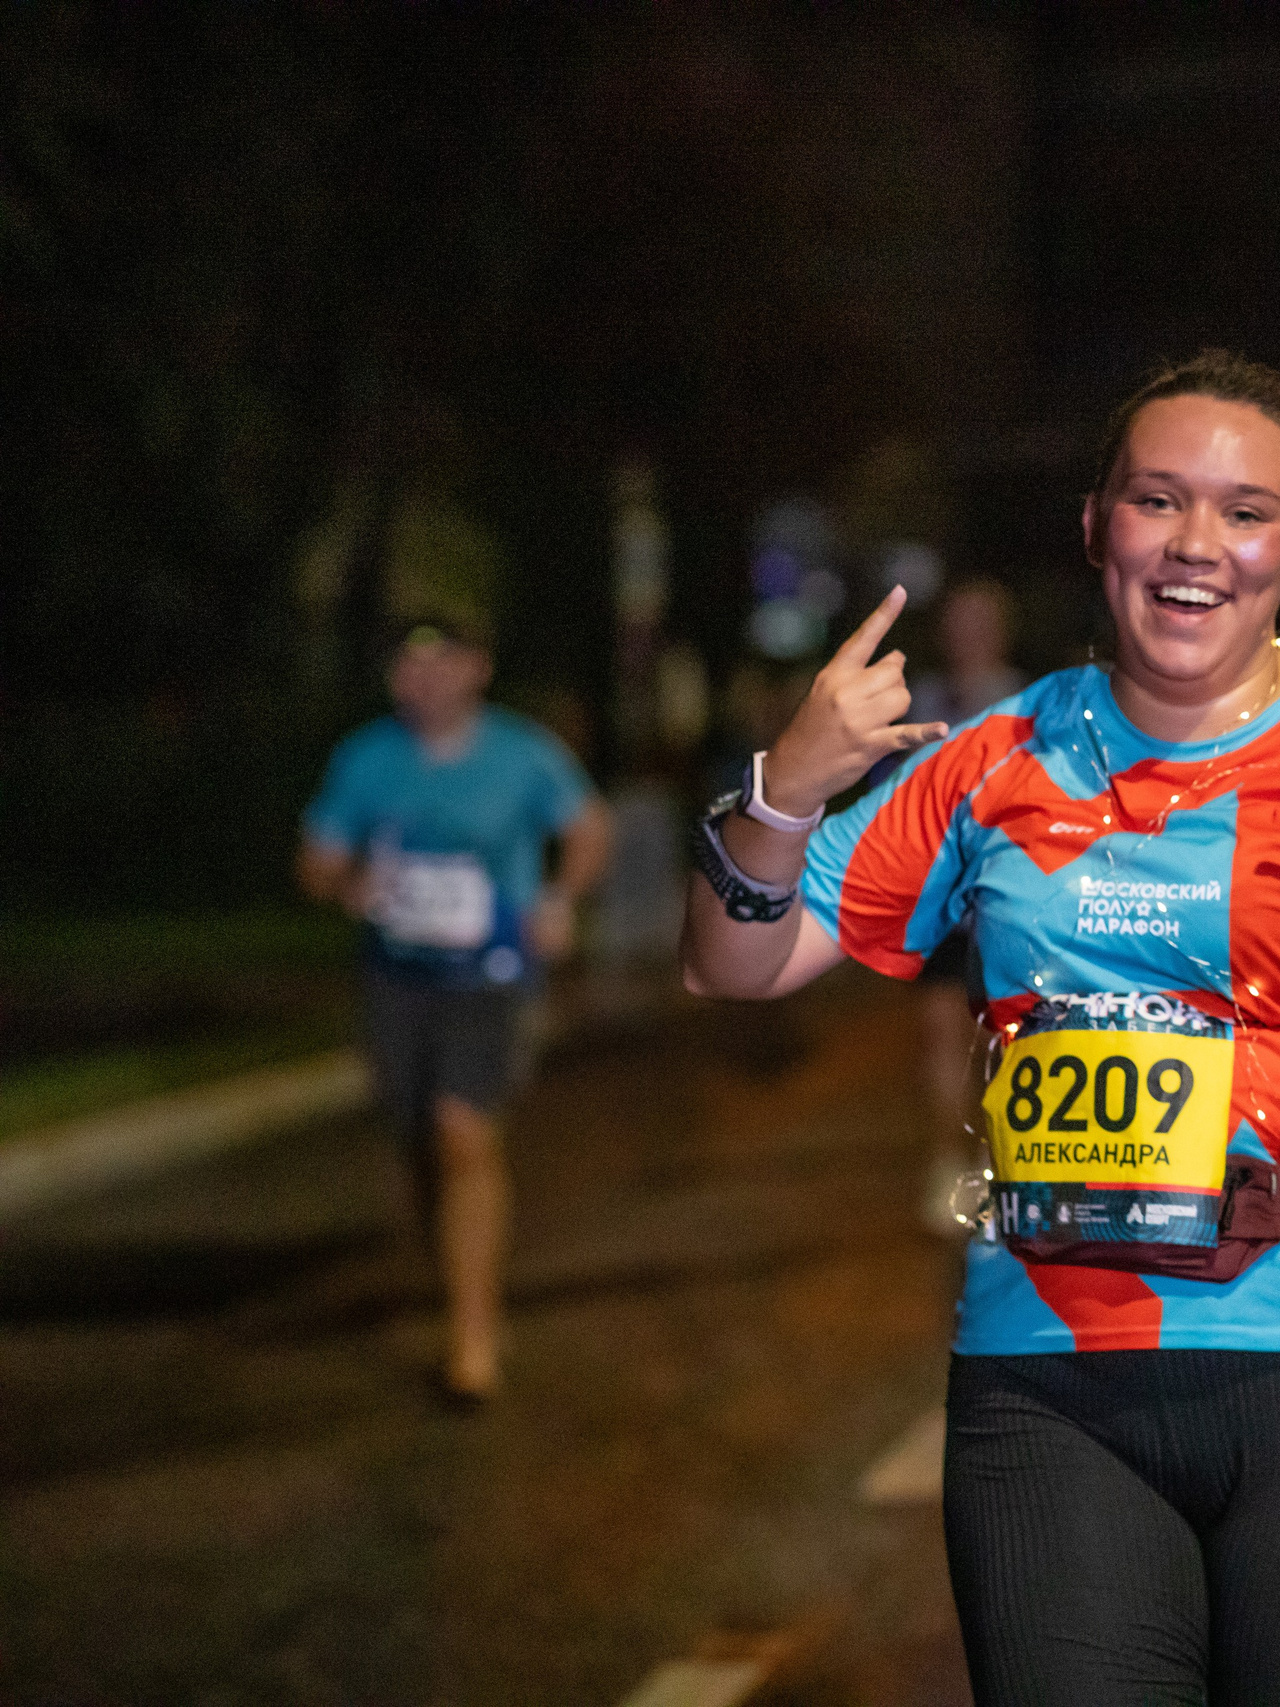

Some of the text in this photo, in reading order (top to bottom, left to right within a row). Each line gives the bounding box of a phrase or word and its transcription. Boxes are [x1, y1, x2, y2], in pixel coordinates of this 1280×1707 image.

[1078, 898, 1136, 917] ПОЛУ
[1076, 917, 1180, 938] МАРАФОН
[1006, 1054, 1195, 1134] 8209
[1014, 1142, 1171, 1169] АЛЕКСАНДРА
